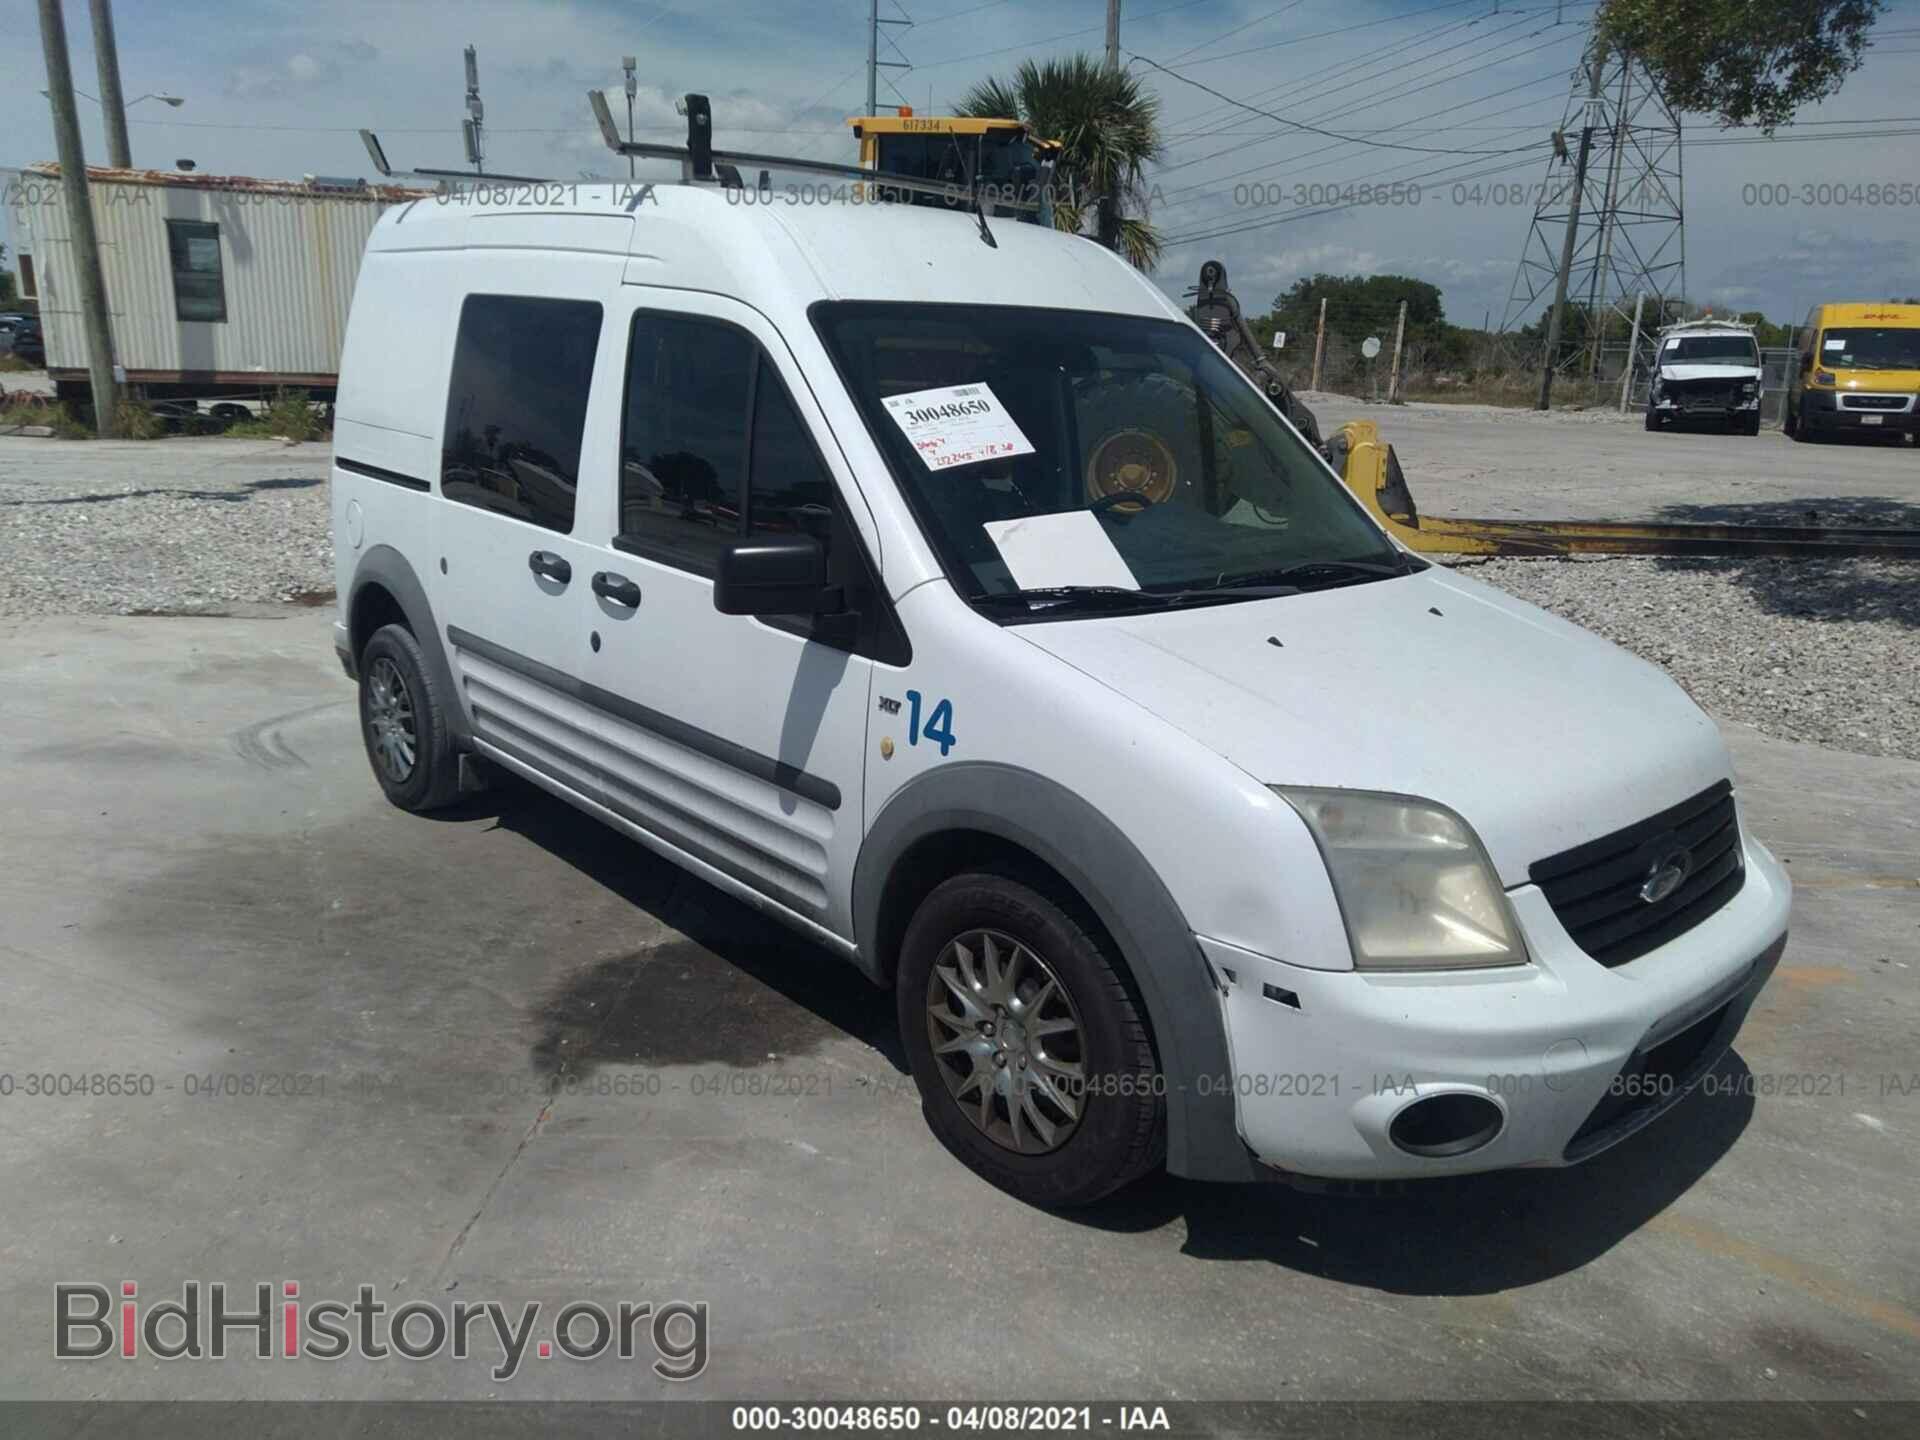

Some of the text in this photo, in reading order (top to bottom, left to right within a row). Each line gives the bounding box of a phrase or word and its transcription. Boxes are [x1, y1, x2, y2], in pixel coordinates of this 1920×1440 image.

[903, 119, 940, 131] 617334
[904, 400, 991, 425] 30048650
[879, 696, 901, 716] XLT
[906, 689, 956, 756] 14
